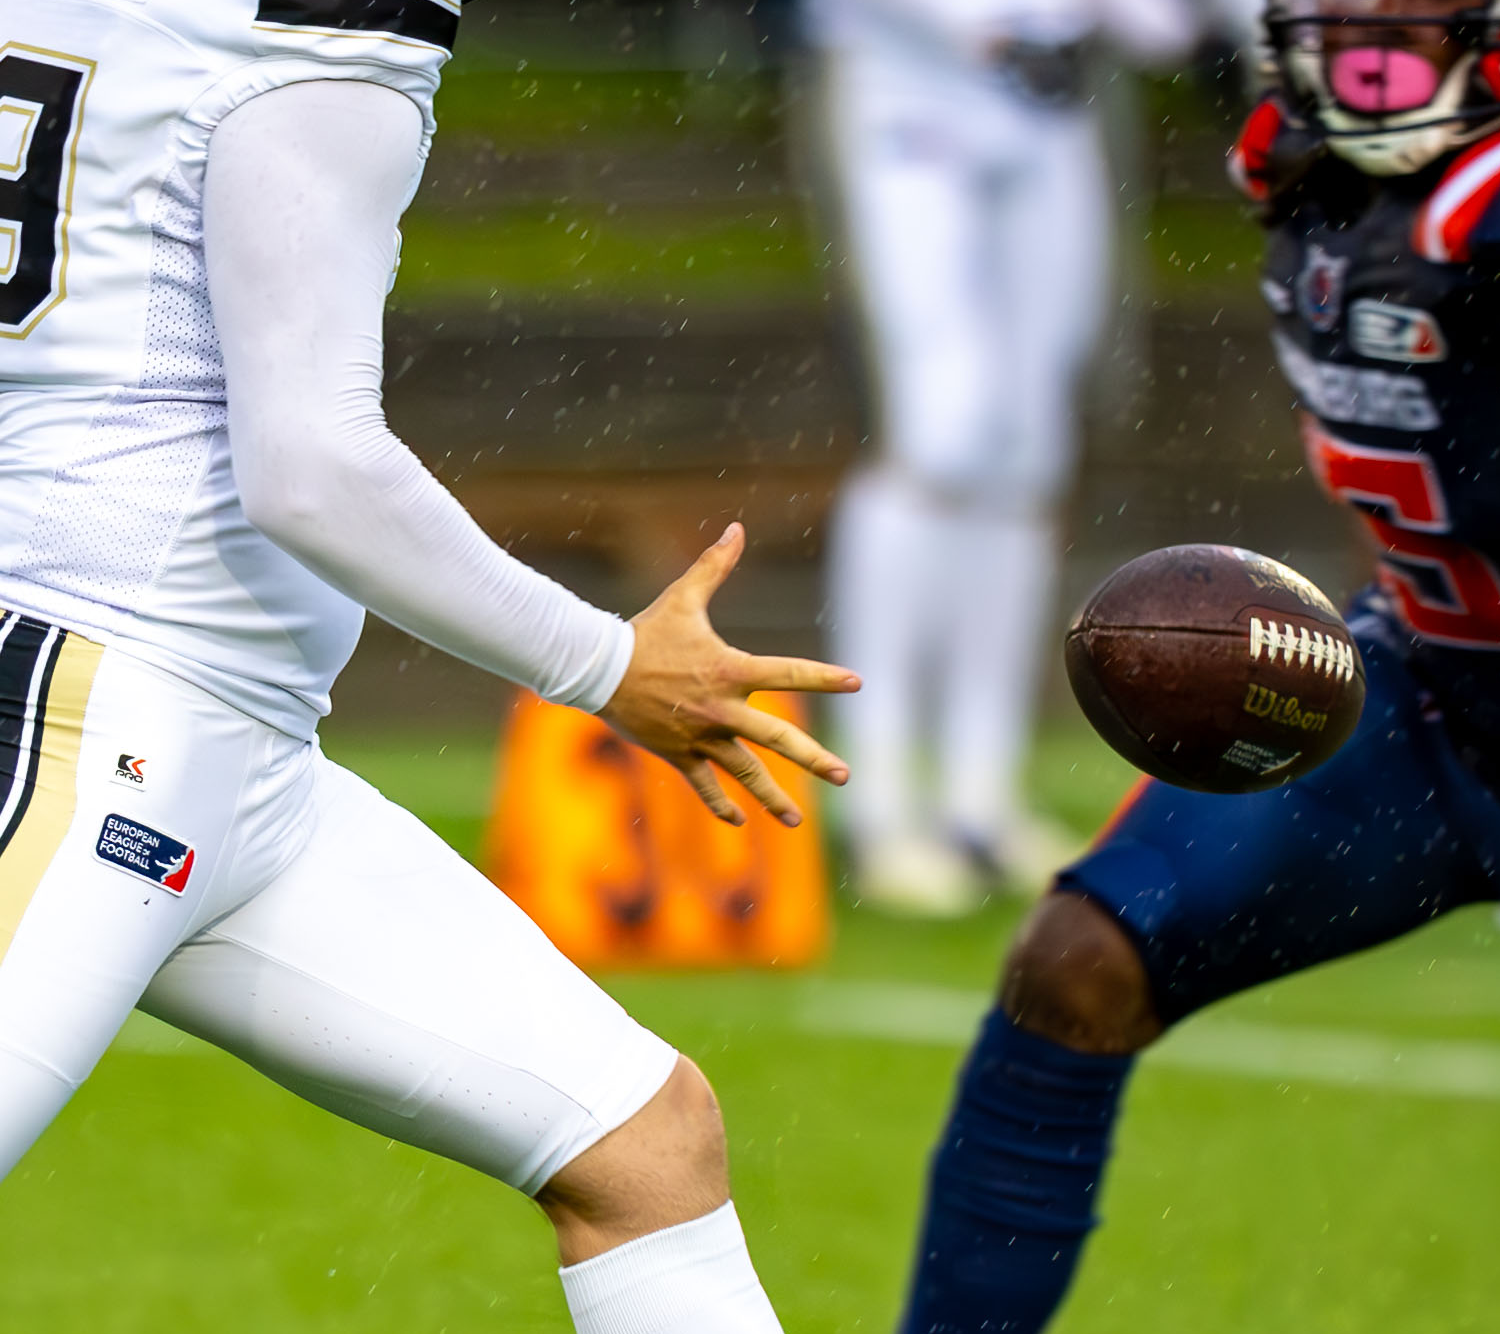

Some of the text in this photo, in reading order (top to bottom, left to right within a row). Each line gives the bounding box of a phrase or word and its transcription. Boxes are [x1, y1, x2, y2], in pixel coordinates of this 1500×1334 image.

[1243, 683, 1328, 732] Wilson
[115, 769, 144, 784] PRO
[103, 829, 143, 854] LEAGUE
[106, 818, 161, 848] EUROPEAN
[99, 841, 151, 870] FOOTBALL
